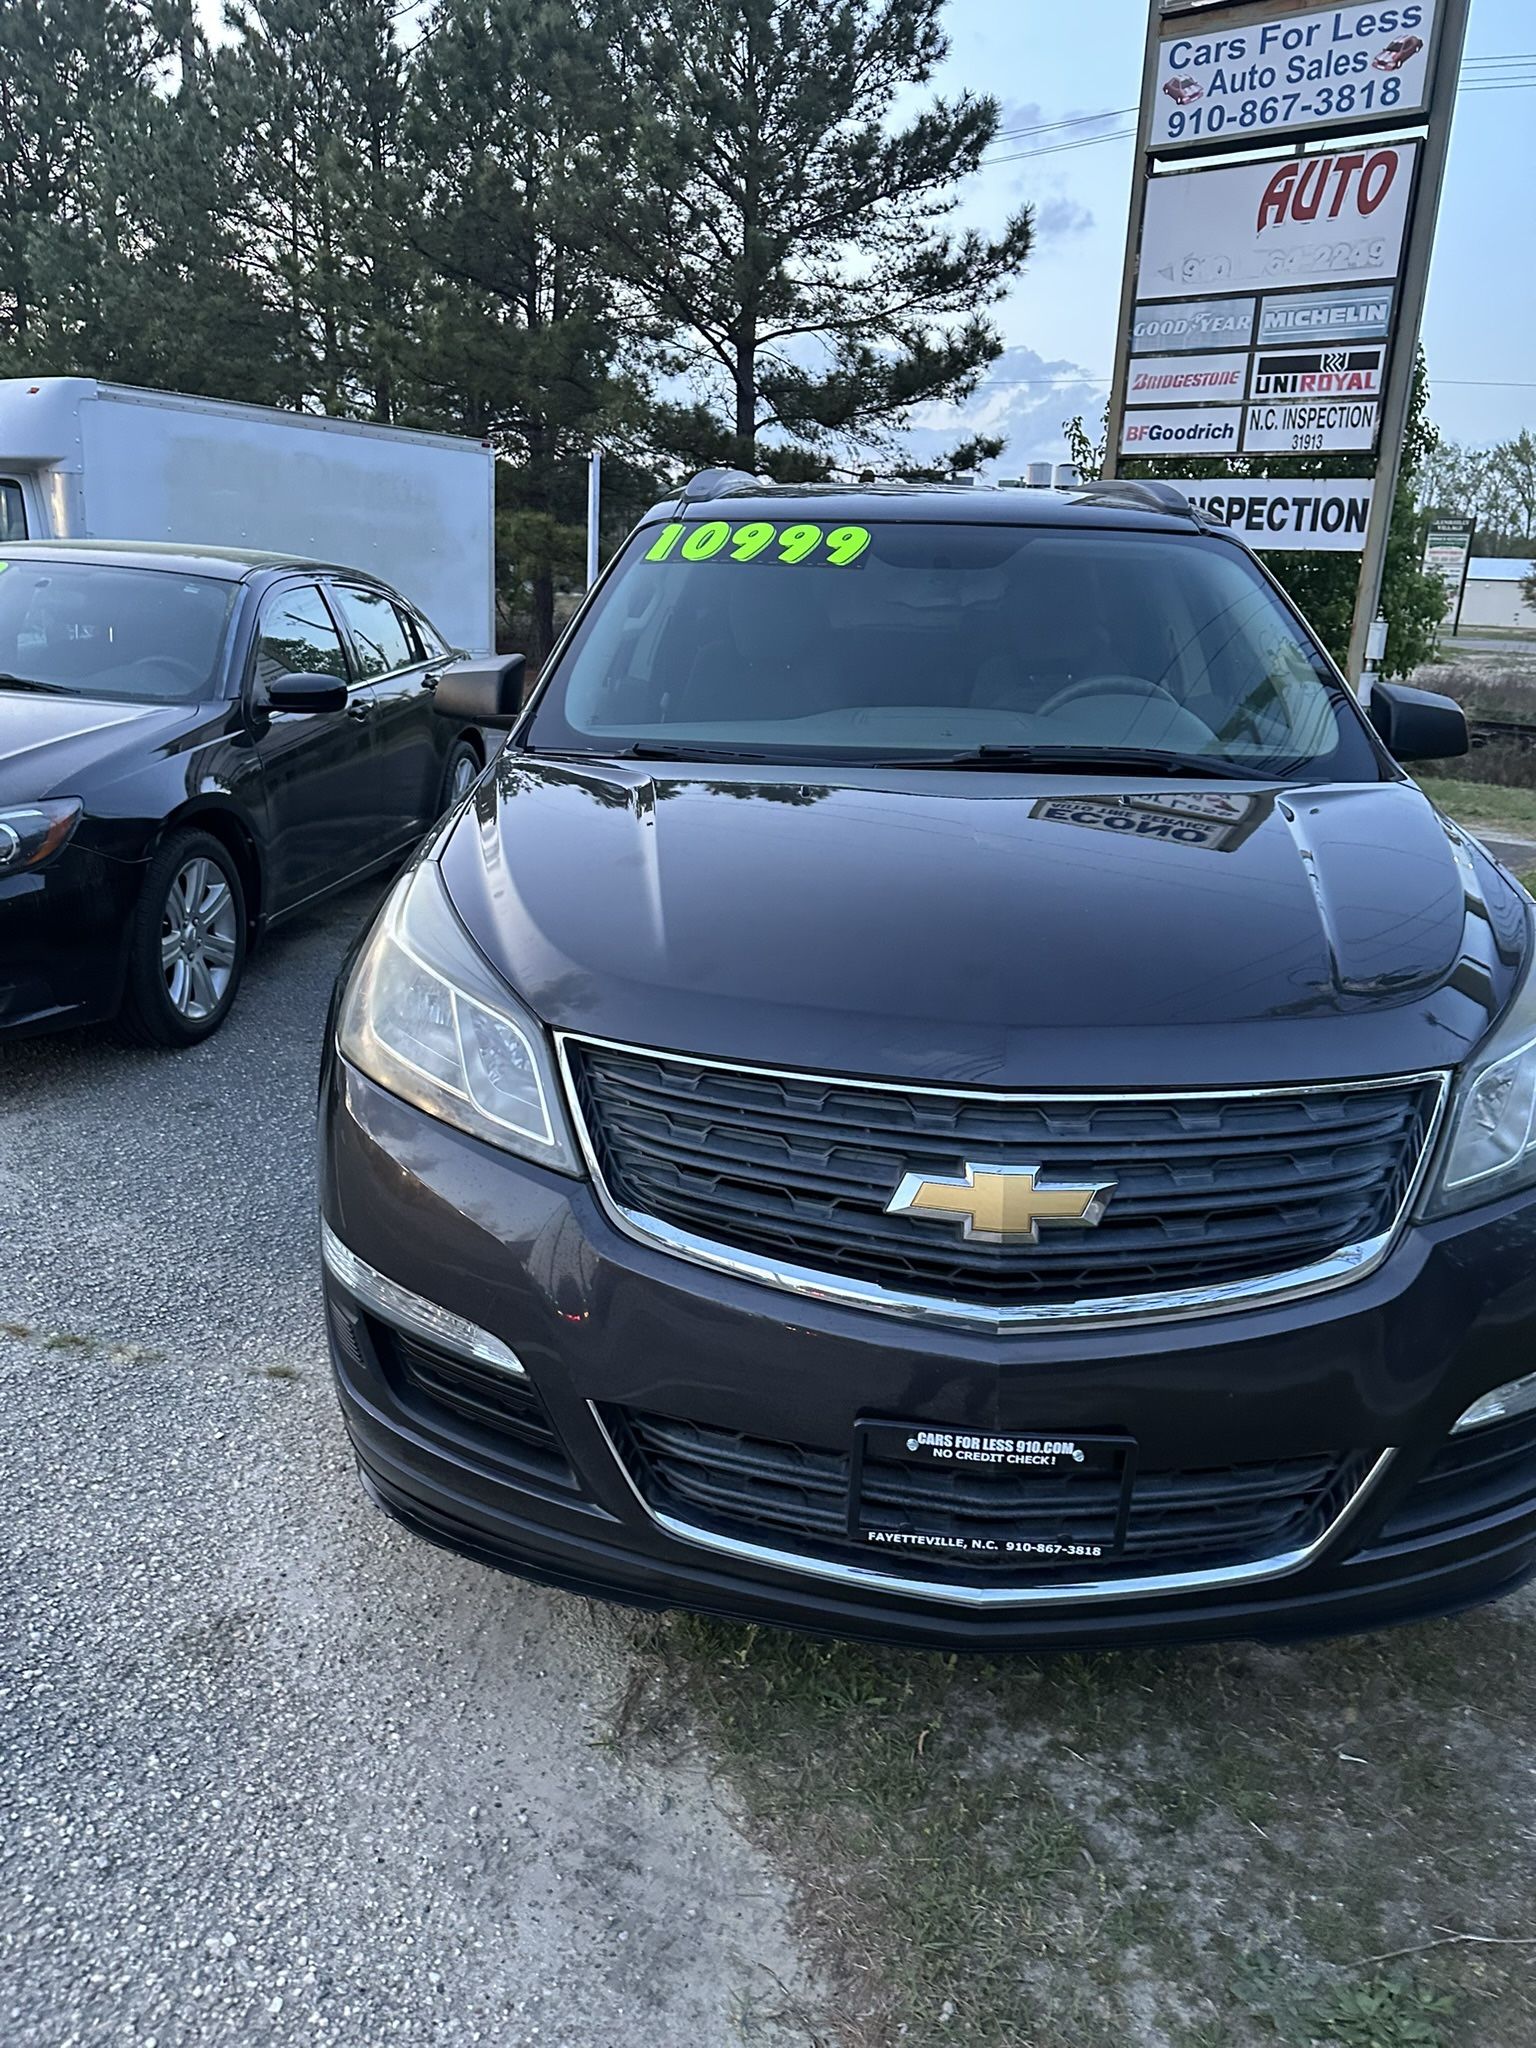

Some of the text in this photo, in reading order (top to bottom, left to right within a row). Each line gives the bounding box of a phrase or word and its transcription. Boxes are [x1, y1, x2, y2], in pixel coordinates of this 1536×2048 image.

[1168, 4, 1424, 70] Cars For Less
[1206, 49, 1369, 98] Auto Sales
[1167, 77, 1402, 138] 910-867-3818
[1256, 150, 1399, 234] AUTO
[1264, 304, 1389, 329] MICHELIN
[1132, 370, 1241, 391] BRIDGESTONE
[1255, 372, 1377, 394] UNIROYAL
[1249, 405, 1374, 431] N.C. INSPECTION
[1126, 423, 1235, 442] BFGoodrich
[1291, 434, 1324, 450] 31913
[644, 521, 872, 567] 10999
[917, 1432, 1075, 1455] CARS FOR LESS 910.COM
[933, 1448, 955, 1459] NO
[955, 1449, 1005, 1463] CREDIT
[868, 1532, 1101, 1556] FAYETTEVILLE, N.C. 910-867-3818
